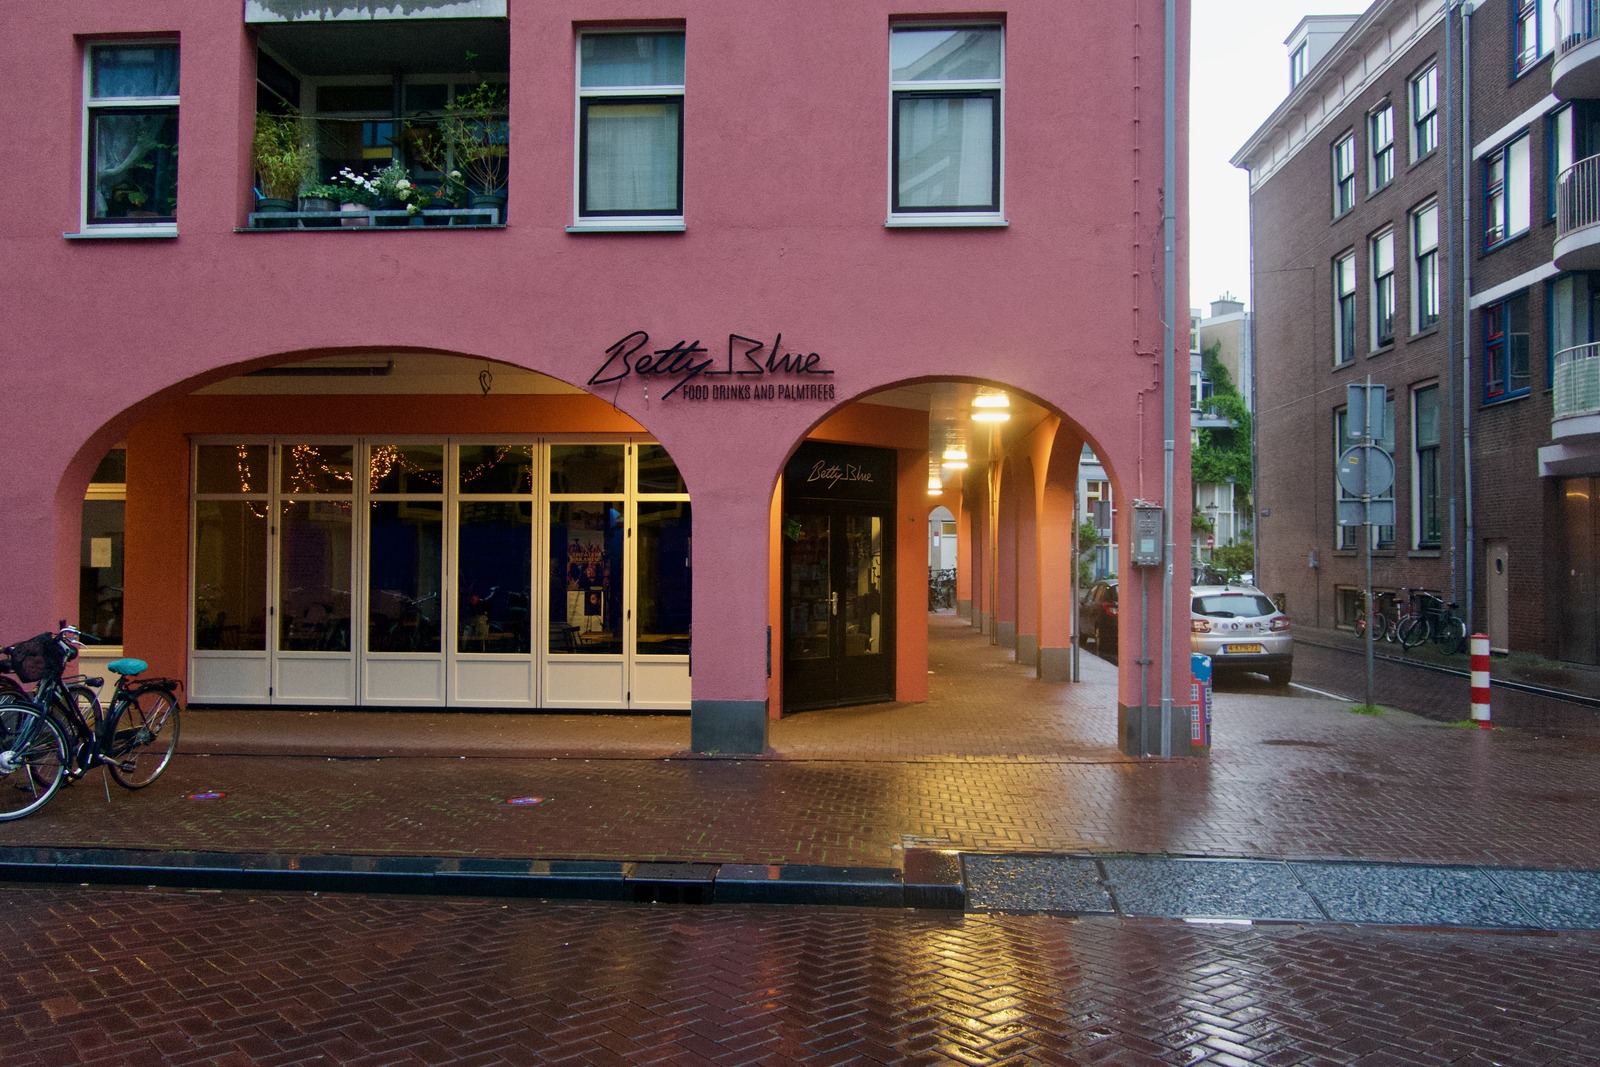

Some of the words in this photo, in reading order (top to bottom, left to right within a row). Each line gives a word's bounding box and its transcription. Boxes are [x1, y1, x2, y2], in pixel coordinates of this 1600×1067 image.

[587, 330, 713, 400] Betty
[704, 333, 835, 375] Blue
[683, 384, 709, 400] FOOD
[712, 384, 751, 400] DRINKS
[753, 384, 775, 400] AND
[778, 383, 835, 400] PALMTREES
[807, 460, 842, 489] Betty
[840, 464, 873, 482] Blue
